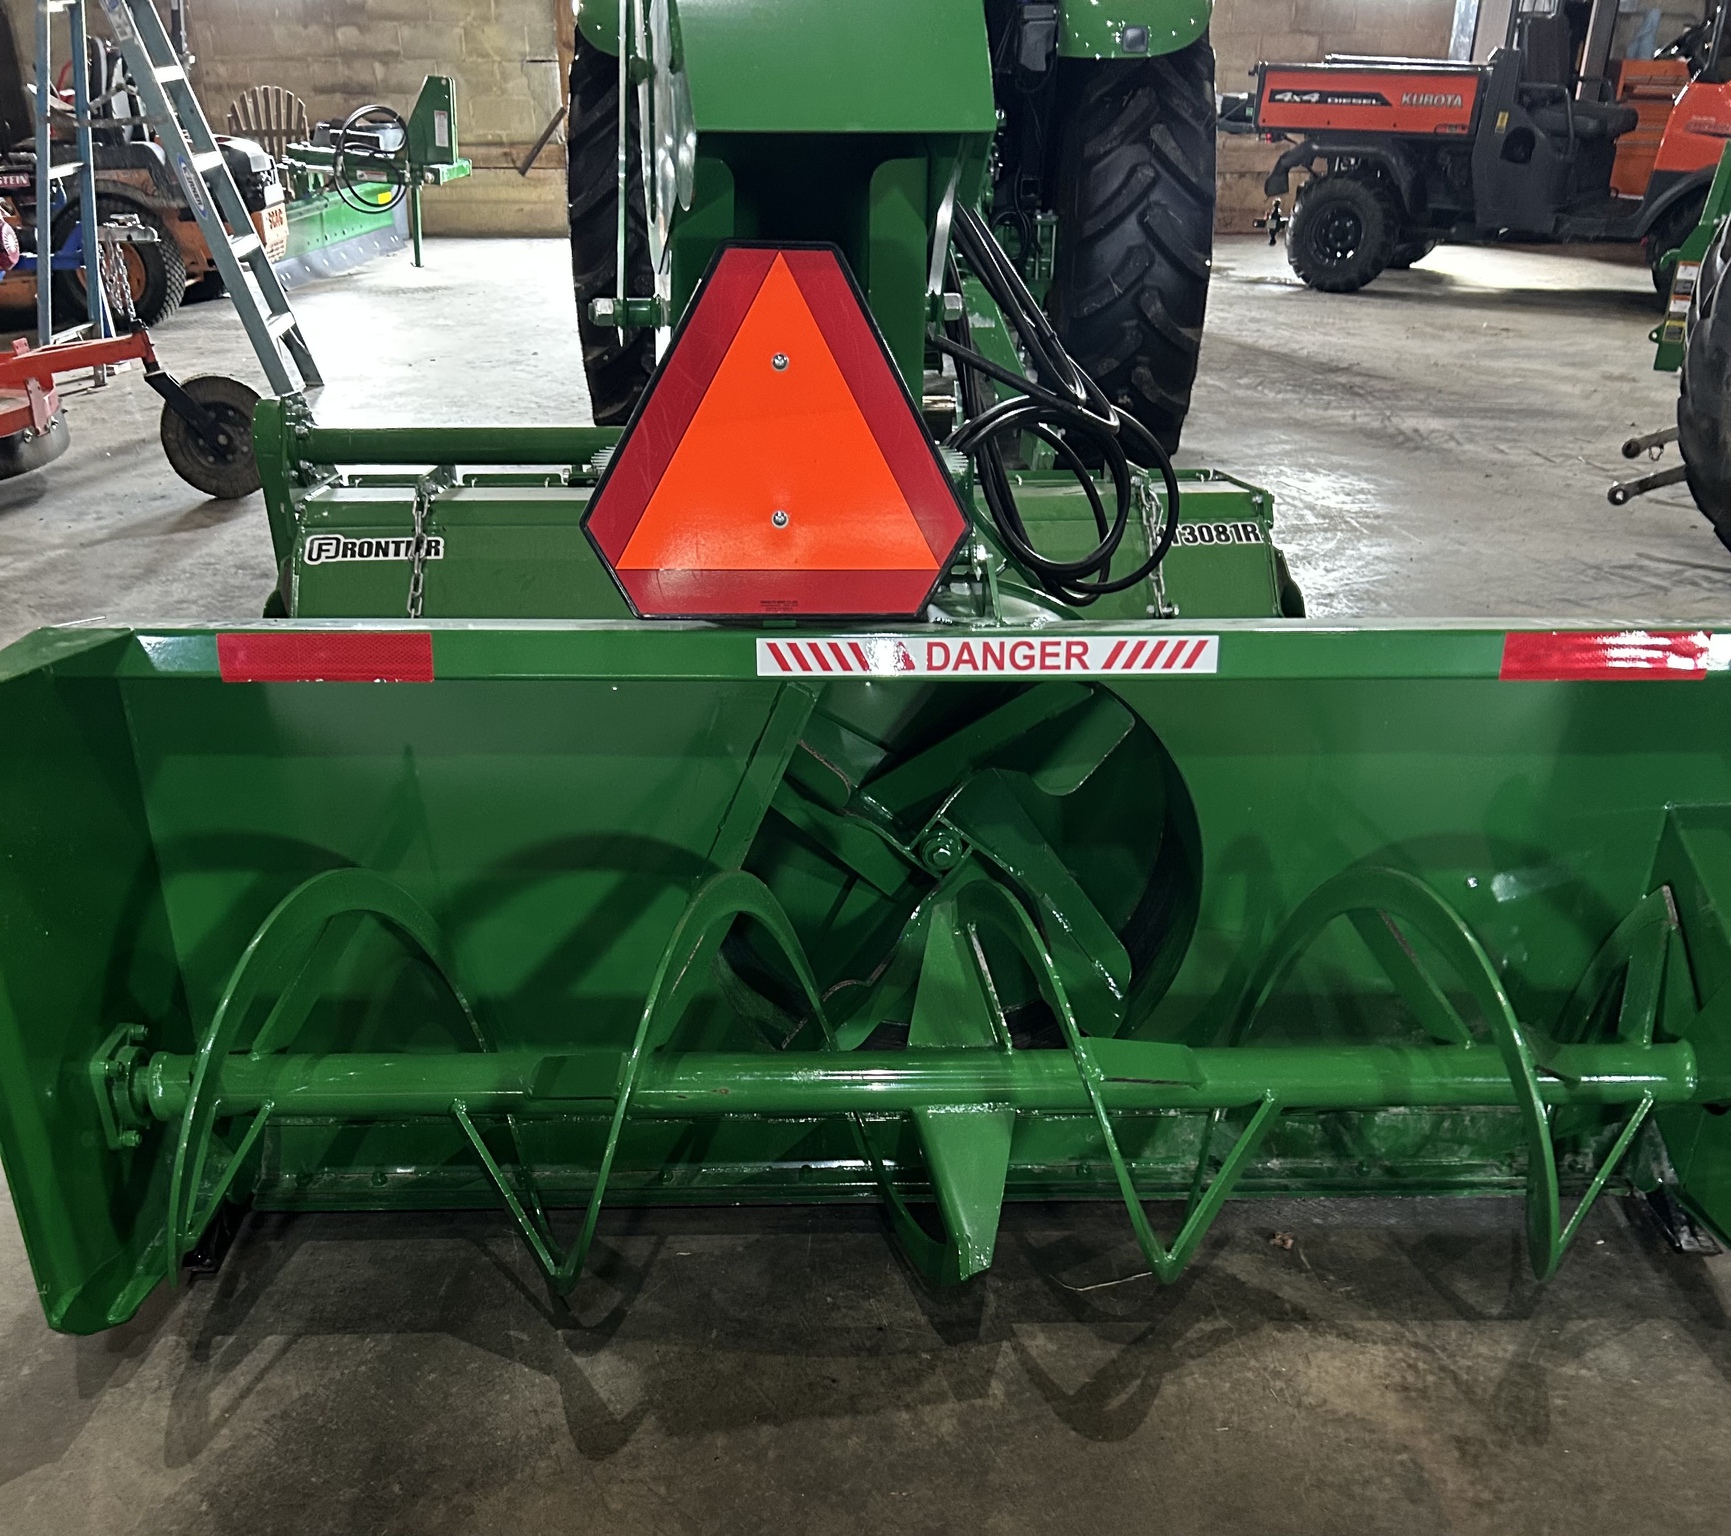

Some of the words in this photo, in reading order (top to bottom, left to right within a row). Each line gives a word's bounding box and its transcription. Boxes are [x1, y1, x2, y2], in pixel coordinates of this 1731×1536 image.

[1275, 91, 1320, 102] 4x4
[1401, 92, 1463, 107] KUBOTA
[307, 537, 441, 561] FRONTIR
[926, 640, 1090, 671] DANGER
